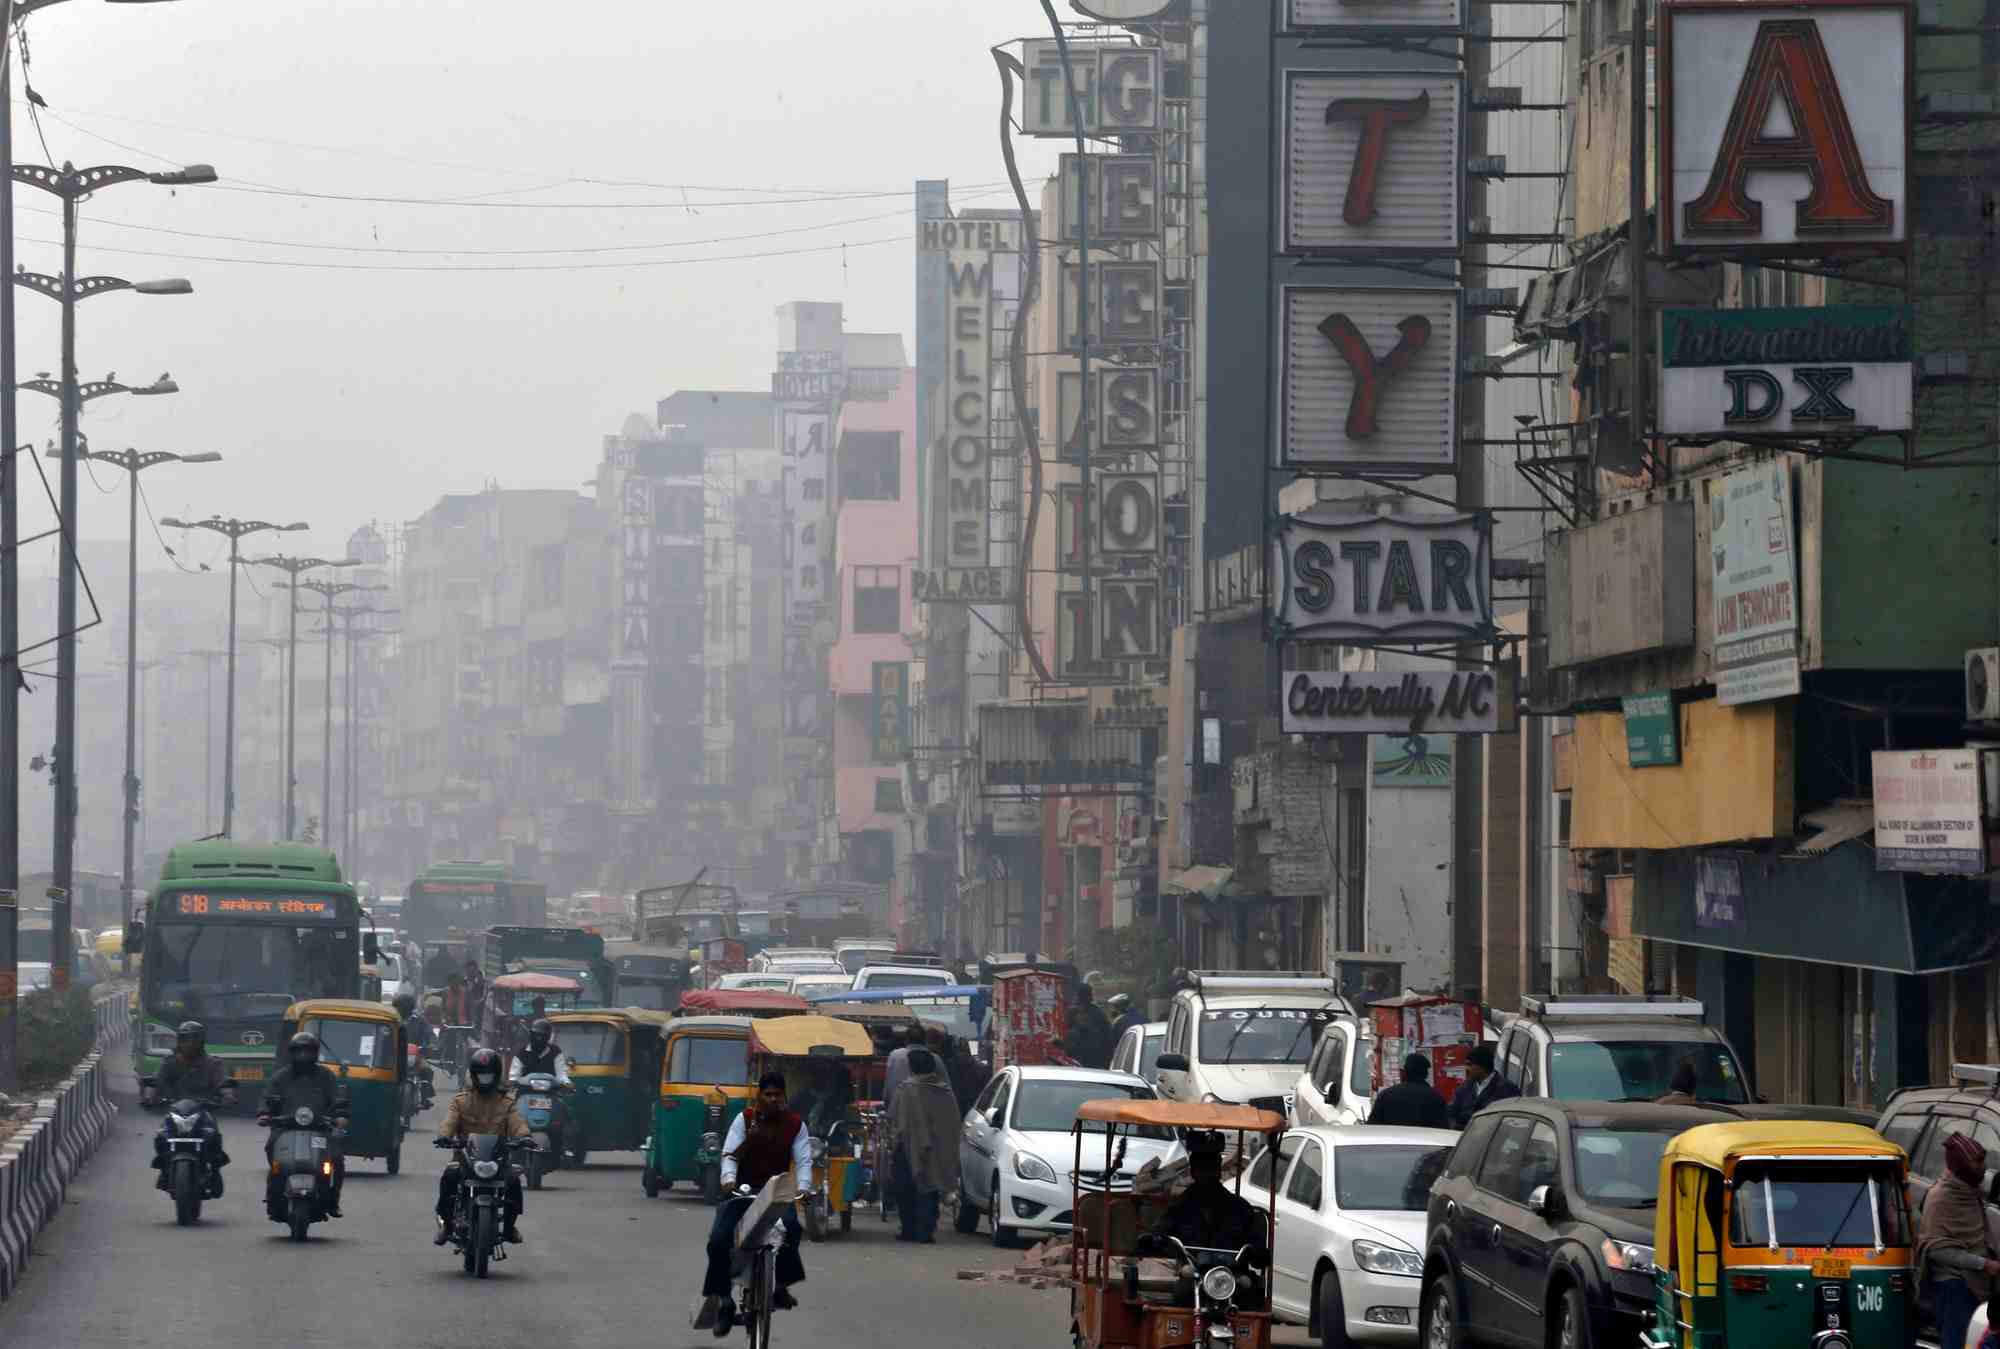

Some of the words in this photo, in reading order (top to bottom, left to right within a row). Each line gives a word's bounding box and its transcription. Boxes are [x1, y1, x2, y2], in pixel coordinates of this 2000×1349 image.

[1683, 18, 1895, 237] A
[920, 221, 1007, 250] HOTEL
[946, 261, 991, 557] WELCOME
[1723, 367, 1856, 425] DX
[911, 570, 1002, 599] PALACE
[1293, 539, 1475, 614] STAR
[1288, 673, 1435, 731] Centerally
[180, 894, 209, 913] 918
[1857, 1286, 1883, 1312] CNG
